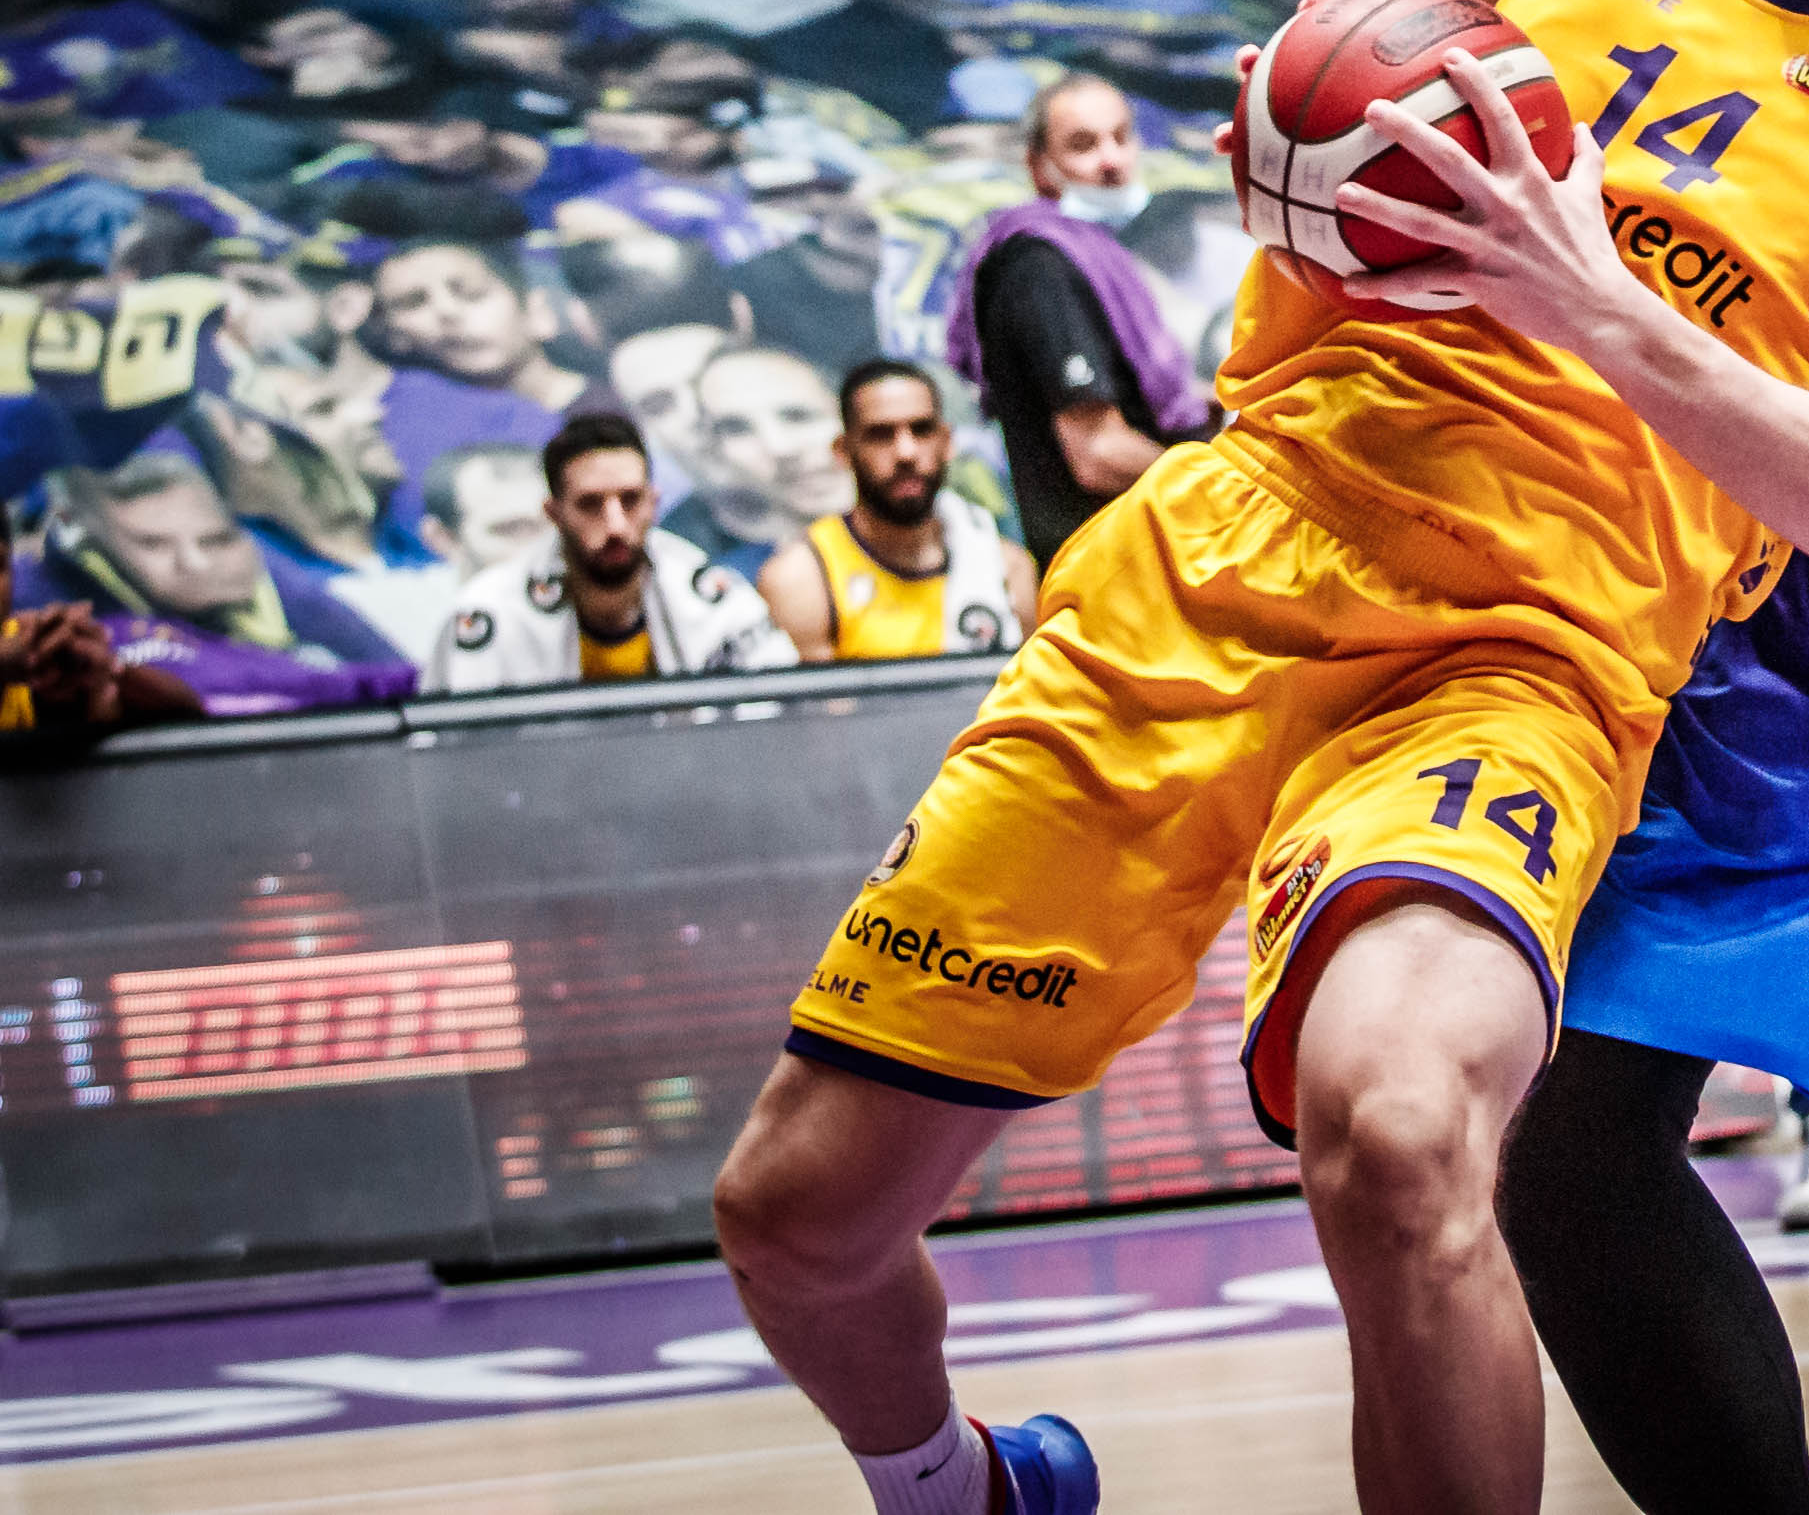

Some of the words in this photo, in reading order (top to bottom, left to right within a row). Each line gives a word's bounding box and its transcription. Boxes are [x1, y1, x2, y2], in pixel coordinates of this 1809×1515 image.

[1590, 43, 1761, 194] 14
[1601, 190, 1755, 328] redit
[1416, 758, 1557, 885] 14
[845, 908, 1077, 1008] unetcredit
[1259, 875, 1308, 951] Winner
